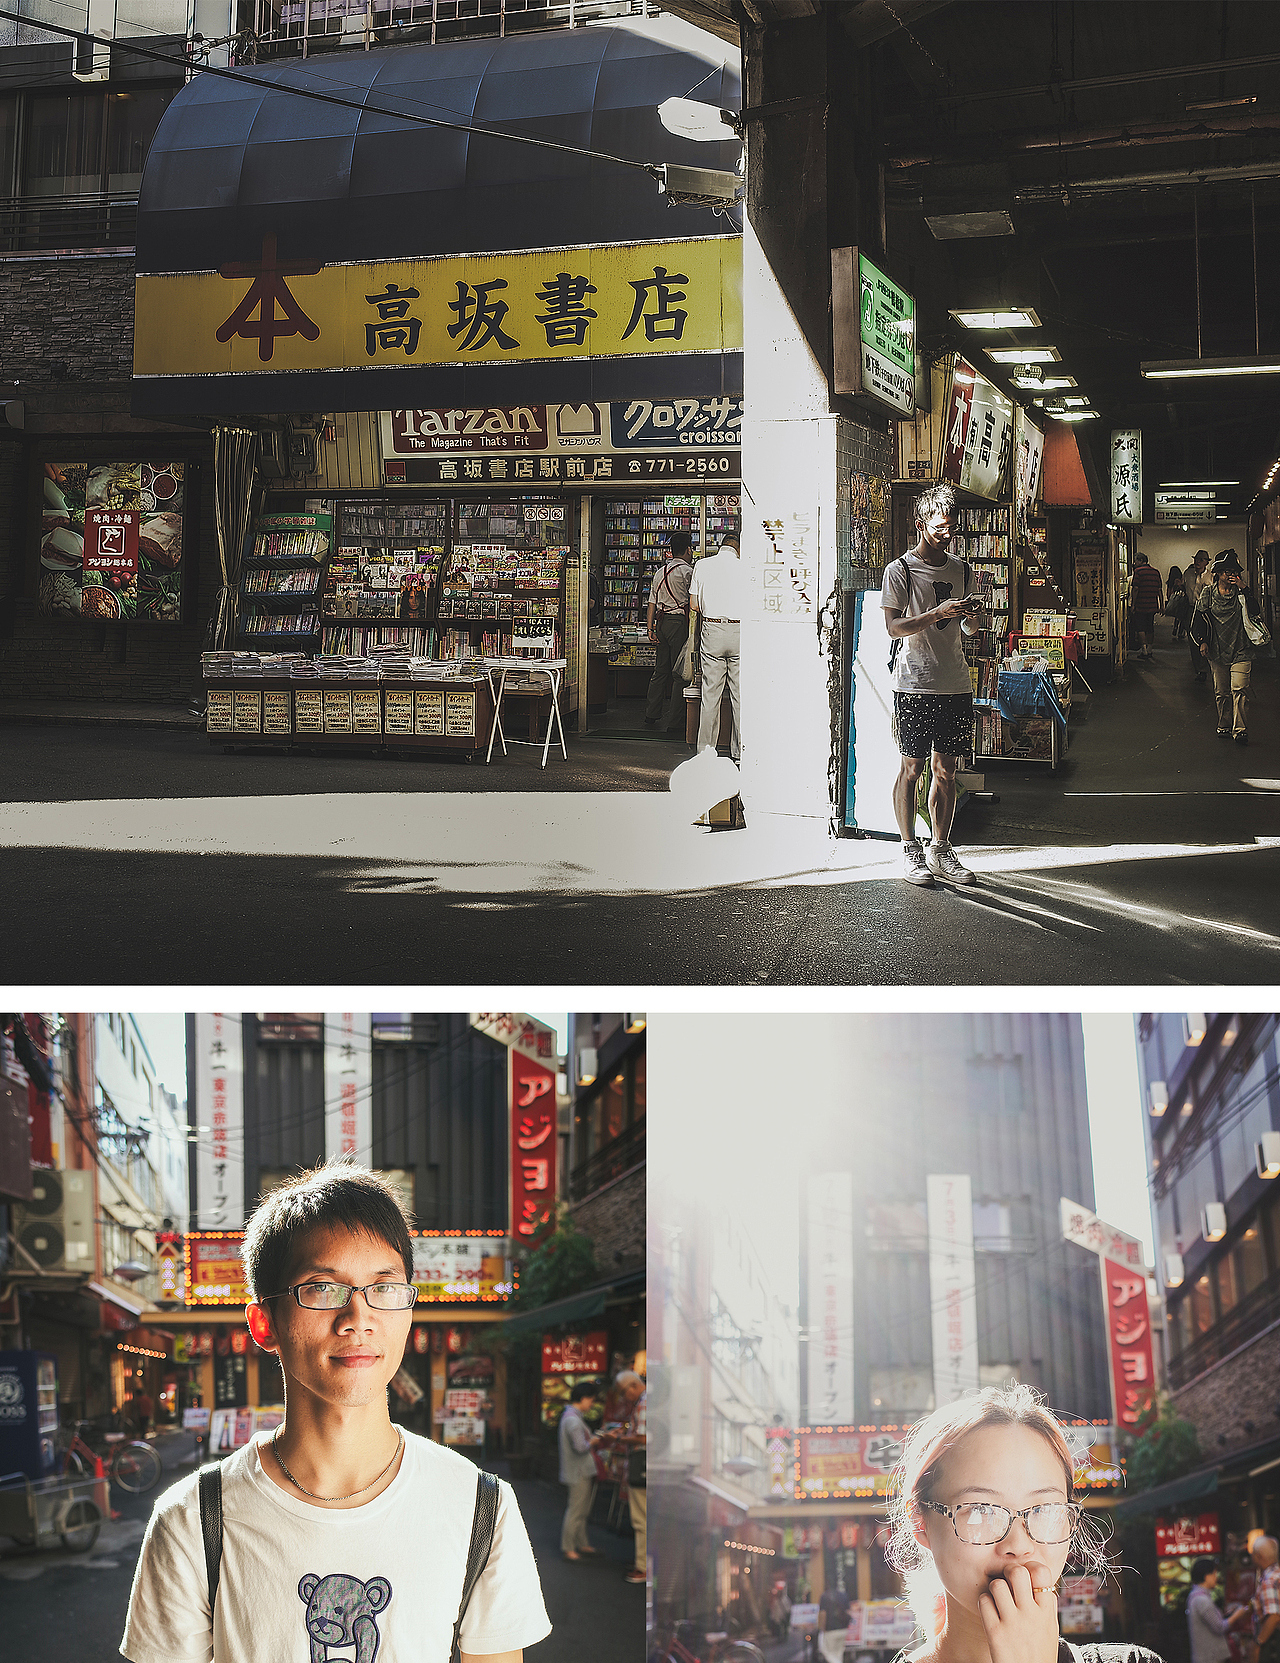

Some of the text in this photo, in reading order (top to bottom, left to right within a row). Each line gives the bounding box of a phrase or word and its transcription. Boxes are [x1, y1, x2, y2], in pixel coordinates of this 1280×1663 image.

[364, 266, 690, 357] 高坂書店
[395, 404, 543, 437] Tarzan
[409, 436, 530, 449] The Magazine That's Fit
[438, 457, 613, 479] 高坂書店駅前店
[645, 457, 731, 473] 771-2560
[1114, 462, 1132, 519] 源氏
[760, 518, 785, 614] 禁止区域
[1092, 612, 1105, 621] 2F
